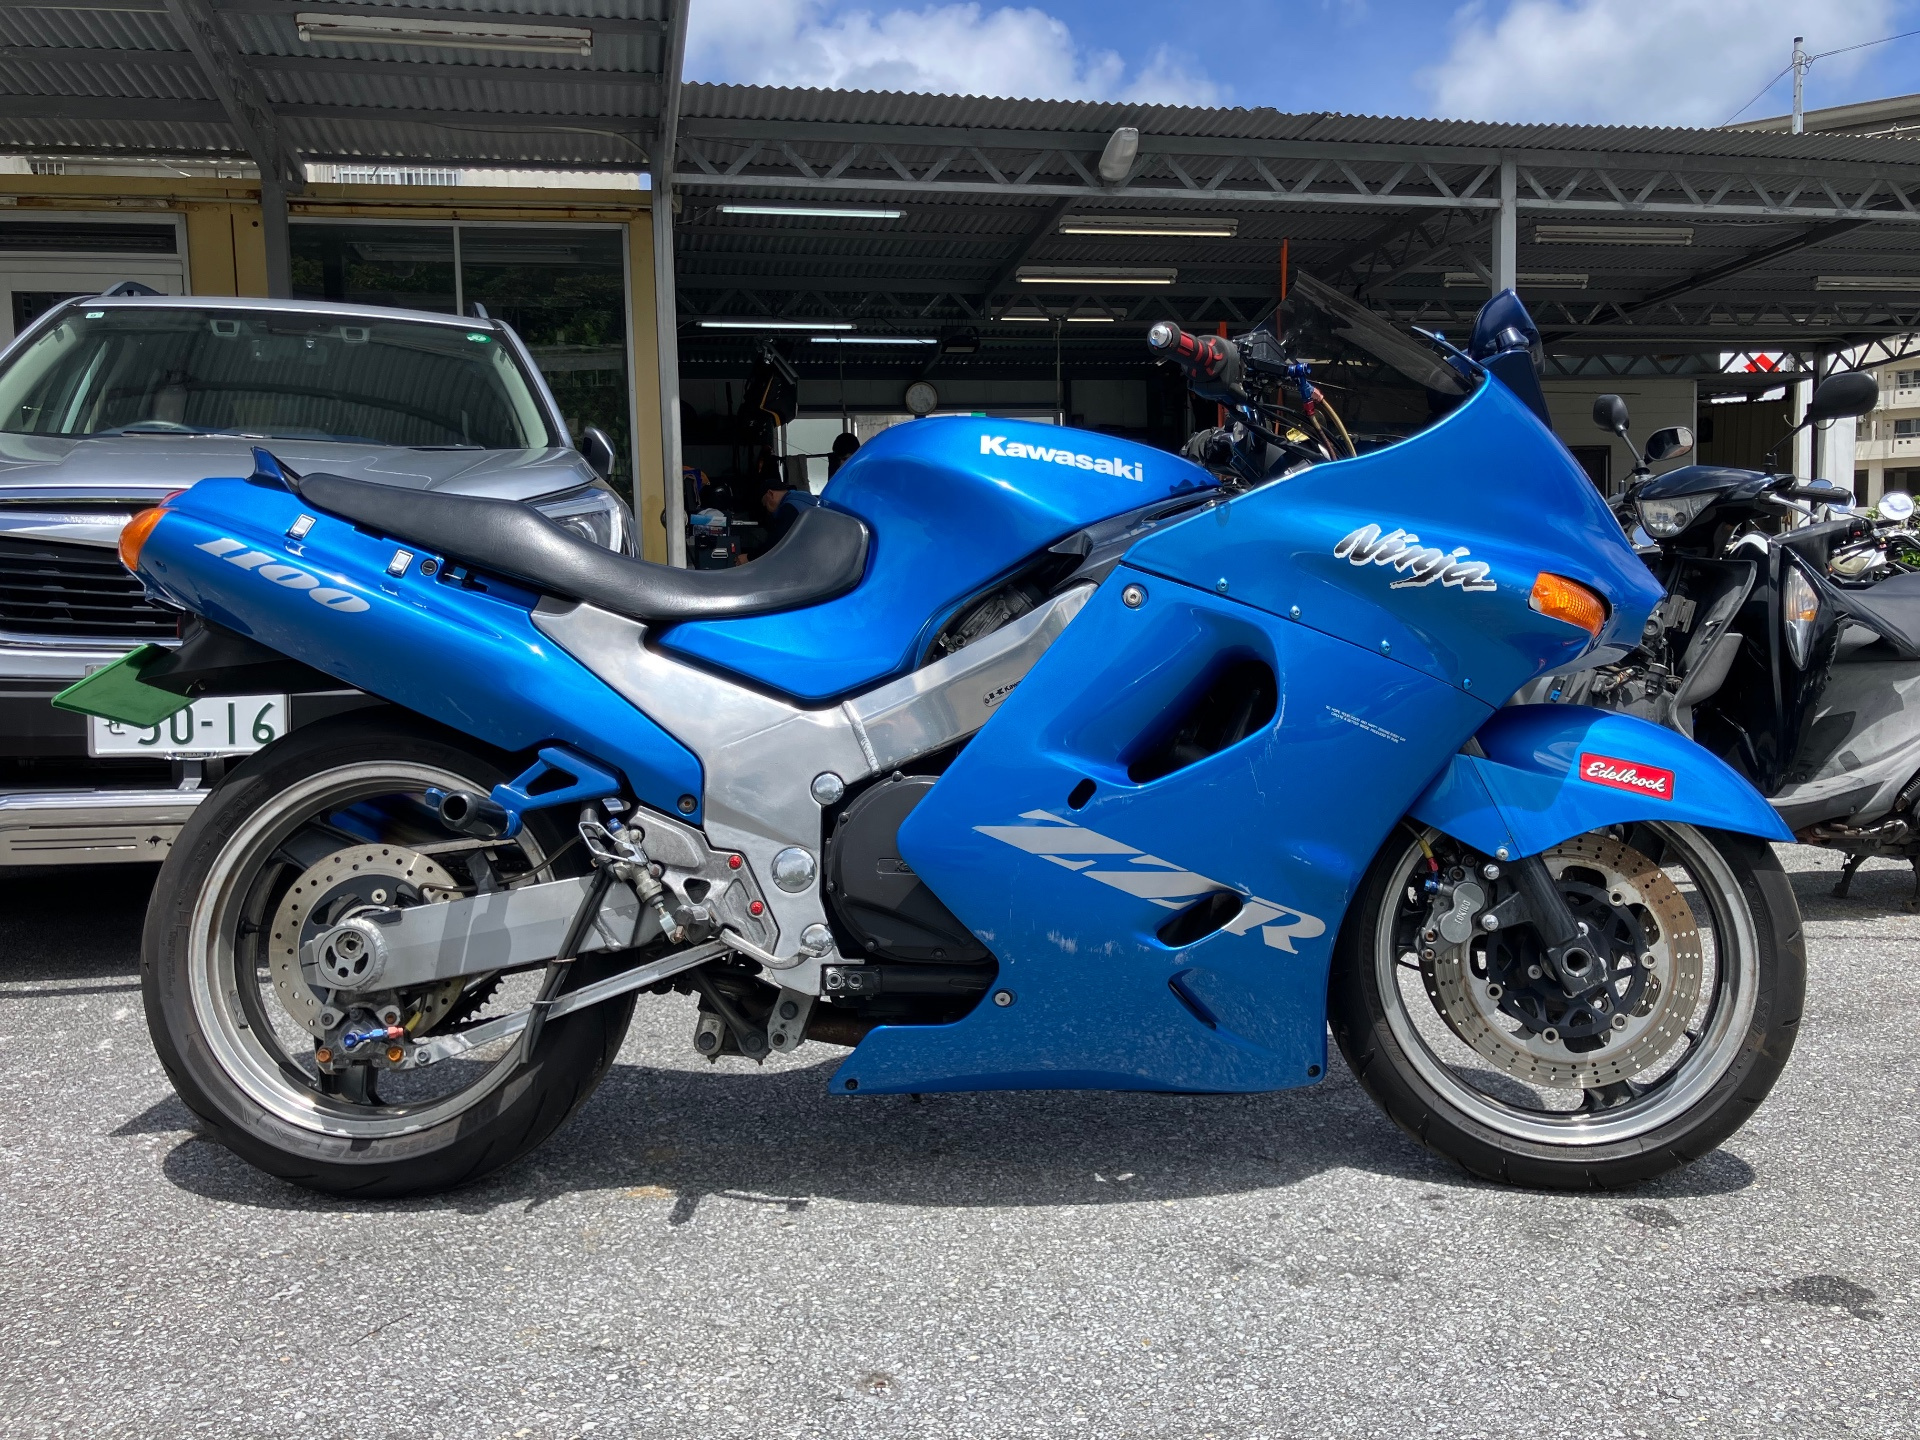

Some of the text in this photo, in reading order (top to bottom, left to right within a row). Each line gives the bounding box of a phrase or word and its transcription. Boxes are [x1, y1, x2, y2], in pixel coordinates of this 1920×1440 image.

[980, 435, 1144, 482] Kawasaki
[194, 537, 371, 612] 1100
[1334, 523, 1498, 592] Ninja
[1586, 761, 1666, 792] Edelbrock
